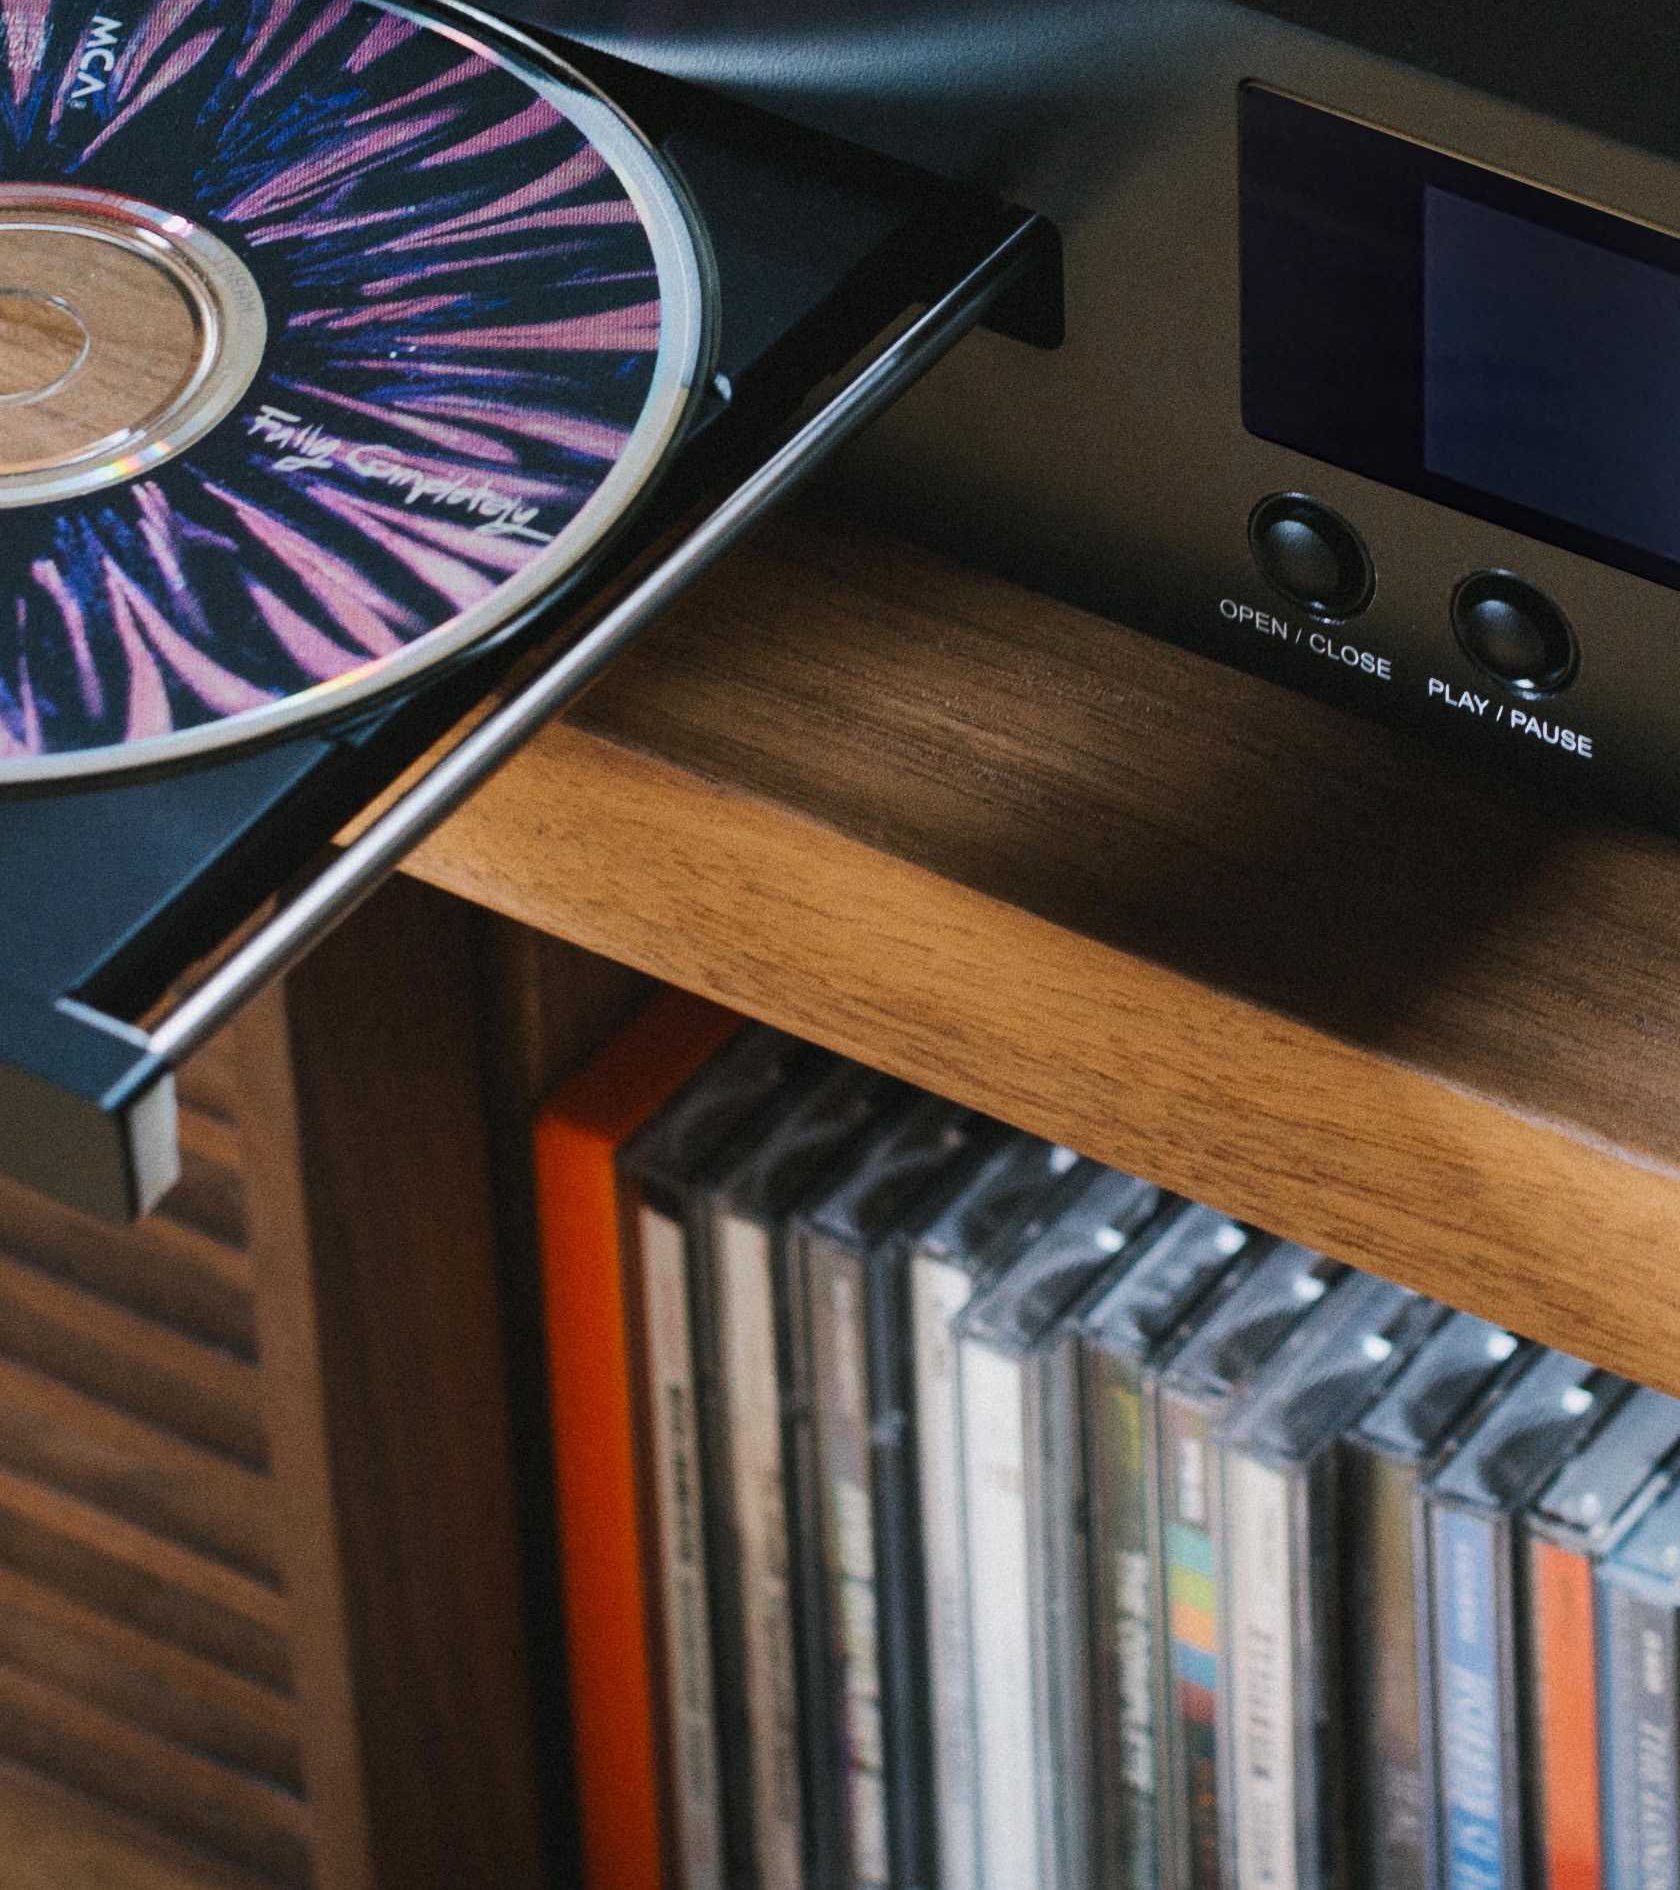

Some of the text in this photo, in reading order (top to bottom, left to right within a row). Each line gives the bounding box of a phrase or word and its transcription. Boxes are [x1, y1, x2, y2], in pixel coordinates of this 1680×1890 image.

[70, 14, 124, 100] MCA
[246, 404, 556, 543] Fully Completely
[1219, 598, 1288, 641] OPEN
[1309, 633, 1392, 681] CLOSE
[1427, 676, 1490, 718] PLAY
[1510, 709, 1594, 759] PAUSE
